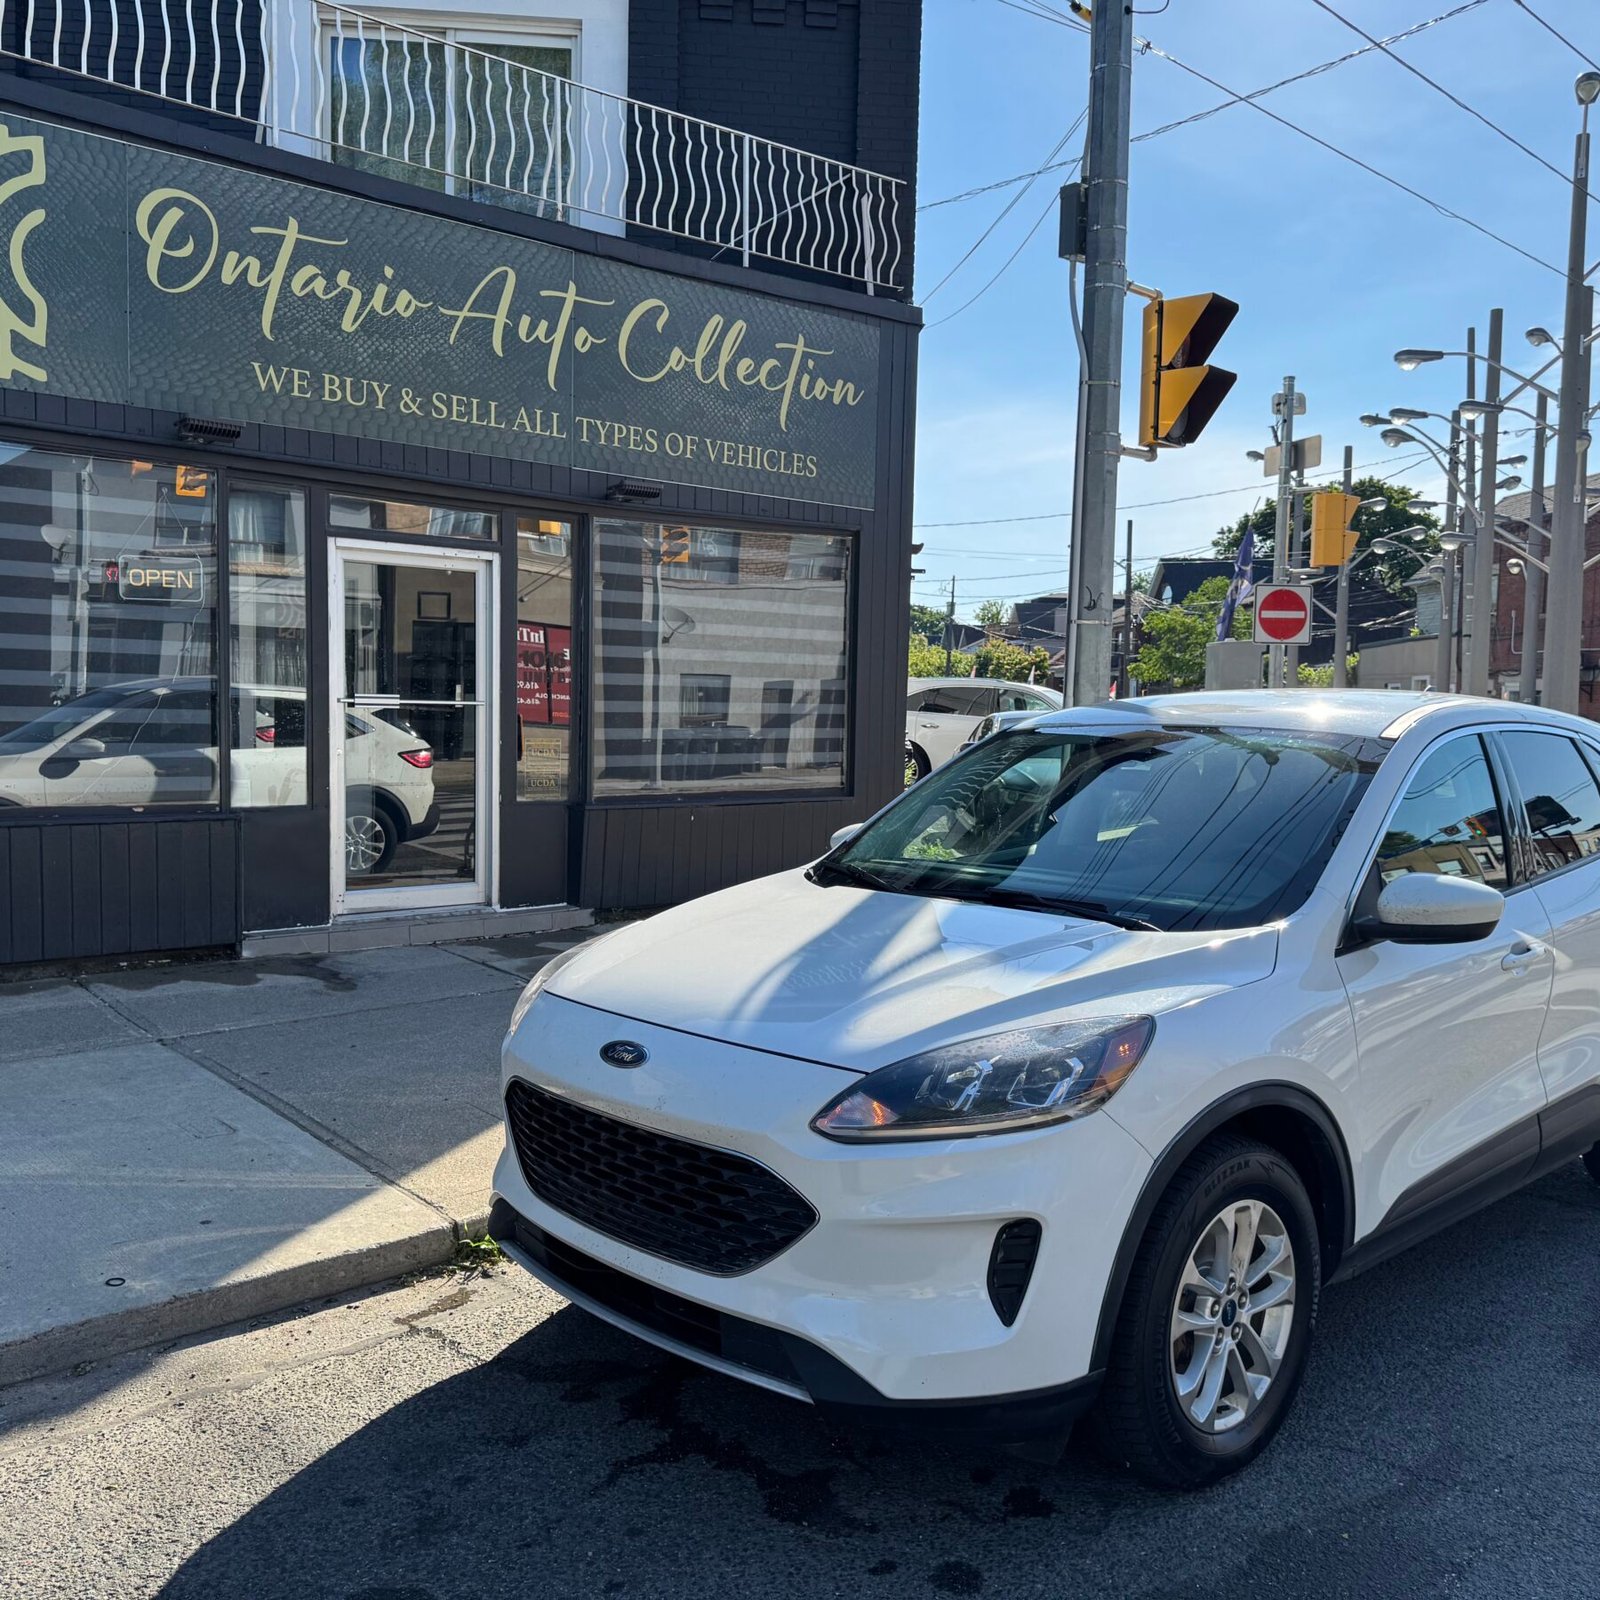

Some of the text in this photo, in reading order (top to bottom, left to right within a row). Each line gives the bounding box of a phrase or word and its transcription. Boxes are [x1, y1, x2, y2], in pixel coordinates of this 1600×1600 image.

[136, 188, 865, 432] Ontario Auto Collection
[250, 362, 818, 478] WE BUY & SELL ALL TYPES OF VEHICLES
[129, 568, 193, 589] OPEN
[531, 748, 556, 757] UCDA
[530, 779, 556, 787] UCDA
